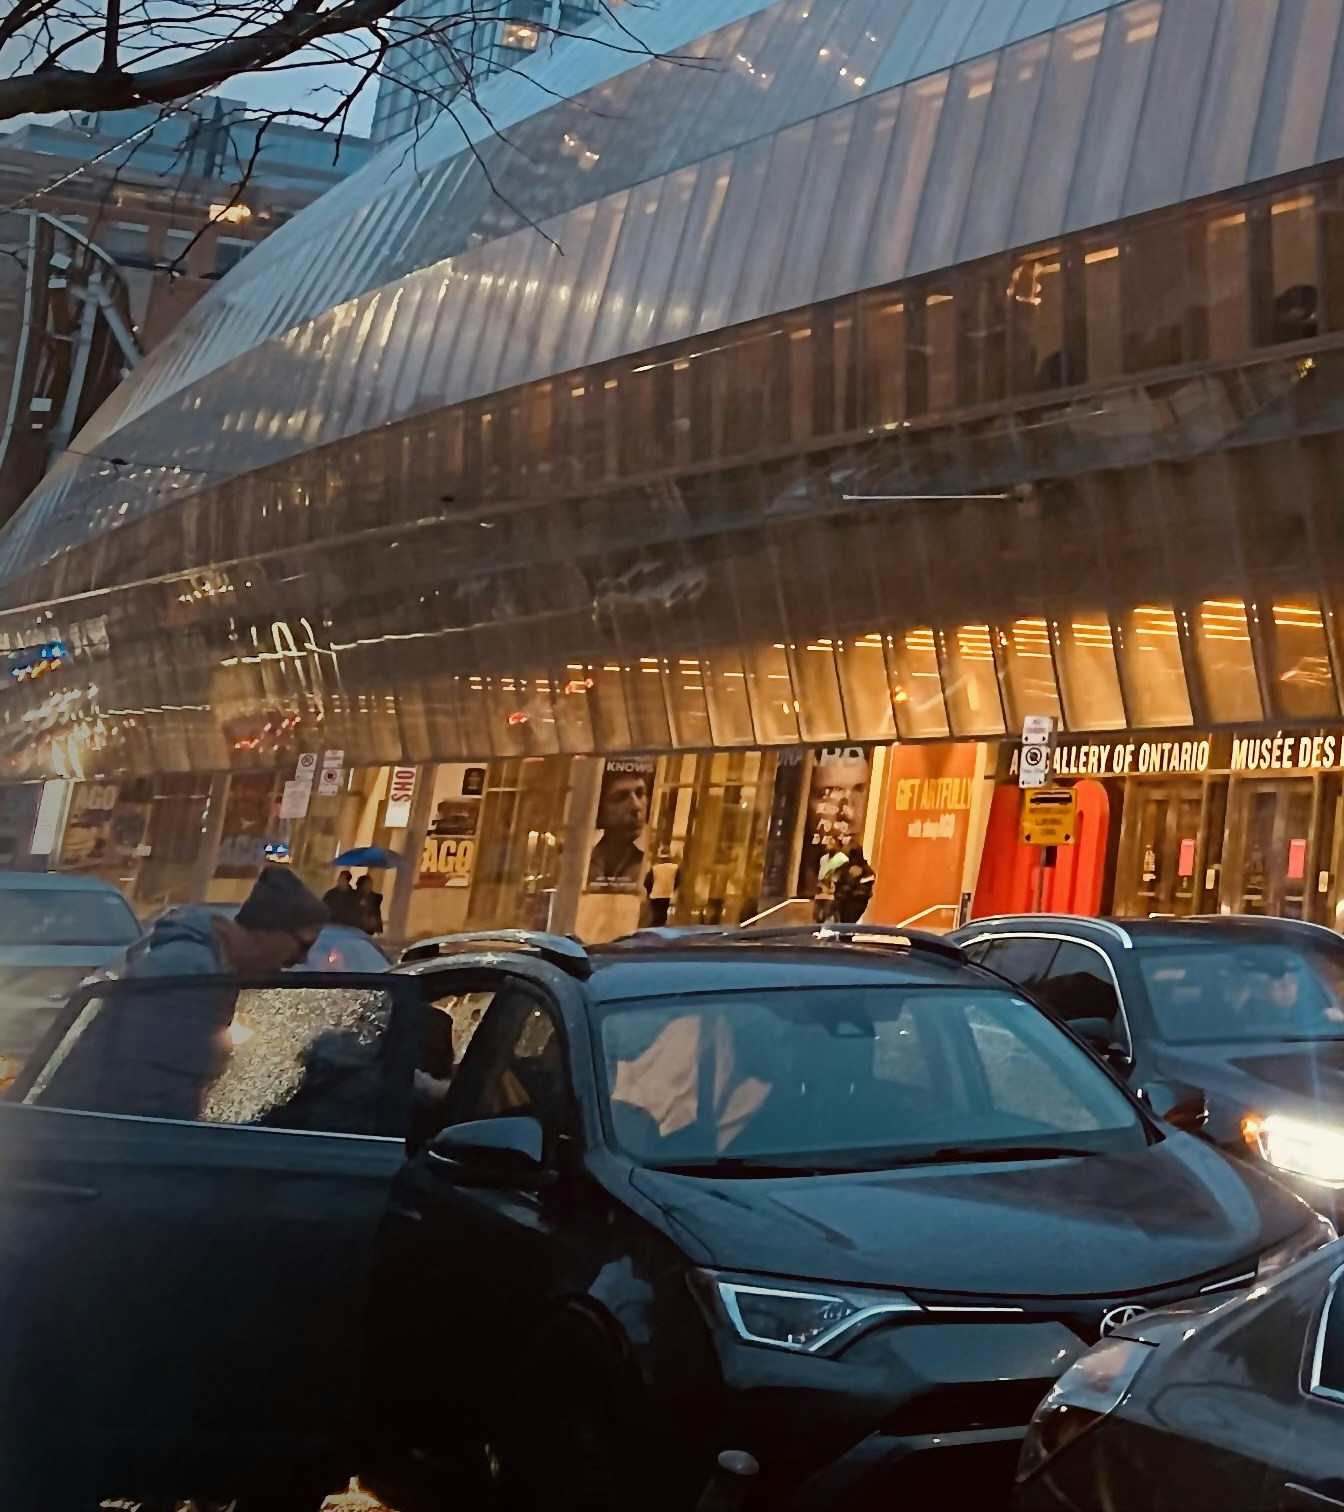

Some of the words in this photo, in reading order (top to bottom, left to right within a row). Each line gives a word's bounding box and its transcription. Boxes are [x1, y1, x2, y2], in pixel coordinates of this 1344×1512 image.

[1112, 744, 1135, 773] OF
[1138, 740, 1210, 772] ONTARIO
[1231, 730, 1295, 770] MUSÉE
[1297, 736, 1336, 769] DES
[606, 761, 654, 773] KNOWS
[75, 784, 116, 811] AGO
[896, 778, 921, 811] GIFT
[920, 777, 972, 810] ARTFULLY
[421, 839, 475, 873] AGO
